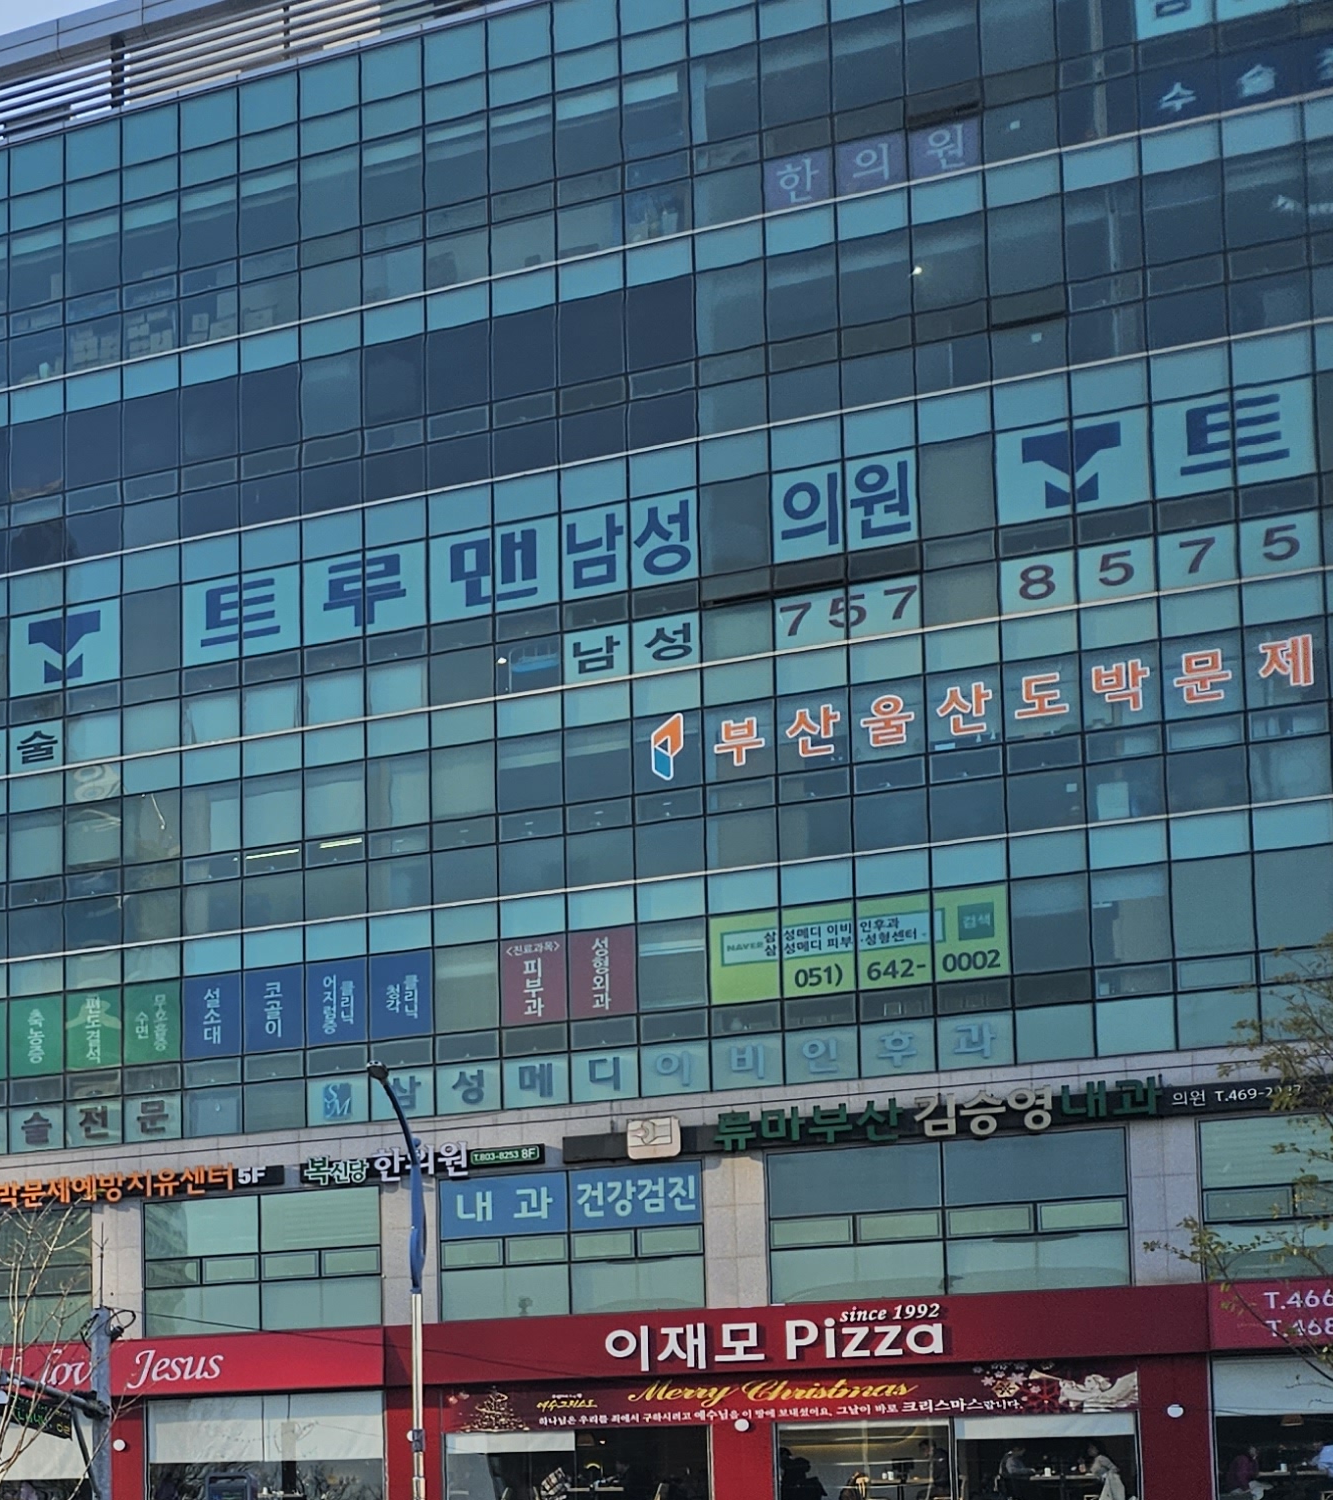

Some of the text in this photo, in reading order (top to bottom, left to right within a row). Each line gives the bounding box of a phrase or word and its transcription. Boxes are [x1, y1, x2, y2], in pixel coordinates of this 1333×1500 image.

[776, 122, 966, 203] 한의원
[781, 460, 911, 546] 의원
[779, 523, 1301, 637] 757 8575
[572, 622, 692, 675] 남성
[522, 957, 545, 1018] 피부과
[590, 936, 612, 1012] 성형외과
[793, 962, 843, 988] 051)
[27, 1008, 45, 1065] 축농증
[84, 993, 103, 1065] 편도결석
[133, 1010, 150, 1041] 수면
[202, 987, 223, 1045] 설소대
[263, 980, 284, 1039] 코골이
[913, 1083, 1055, 1139] 김승영
[1060, 1074, 1164, 1119] 내과
[1171, 1087, 1207, 1108] 의원
[238, 1165, 267, 1185] 5F
[520, 1147, 537, 1160] 8F
[575, 1174, 698, 1219] 건강검진
[840, 1302, 941, 1323] since 1992
[127, 1346, 226, 1390] Jesus
[604, 1316, 946, 1373] 이재모 Pizza
[538, 1414, 575, 1427] 하나님은
[578, 1413, 609, 1426] 우리를
[611, 1412, 640, 1424] 죄에서
[693, 1407, 740, 1422] 예수님을
[741, 1408, 753, 1420] 이
[628, 1377, 919, 1409] Merry Christmas
